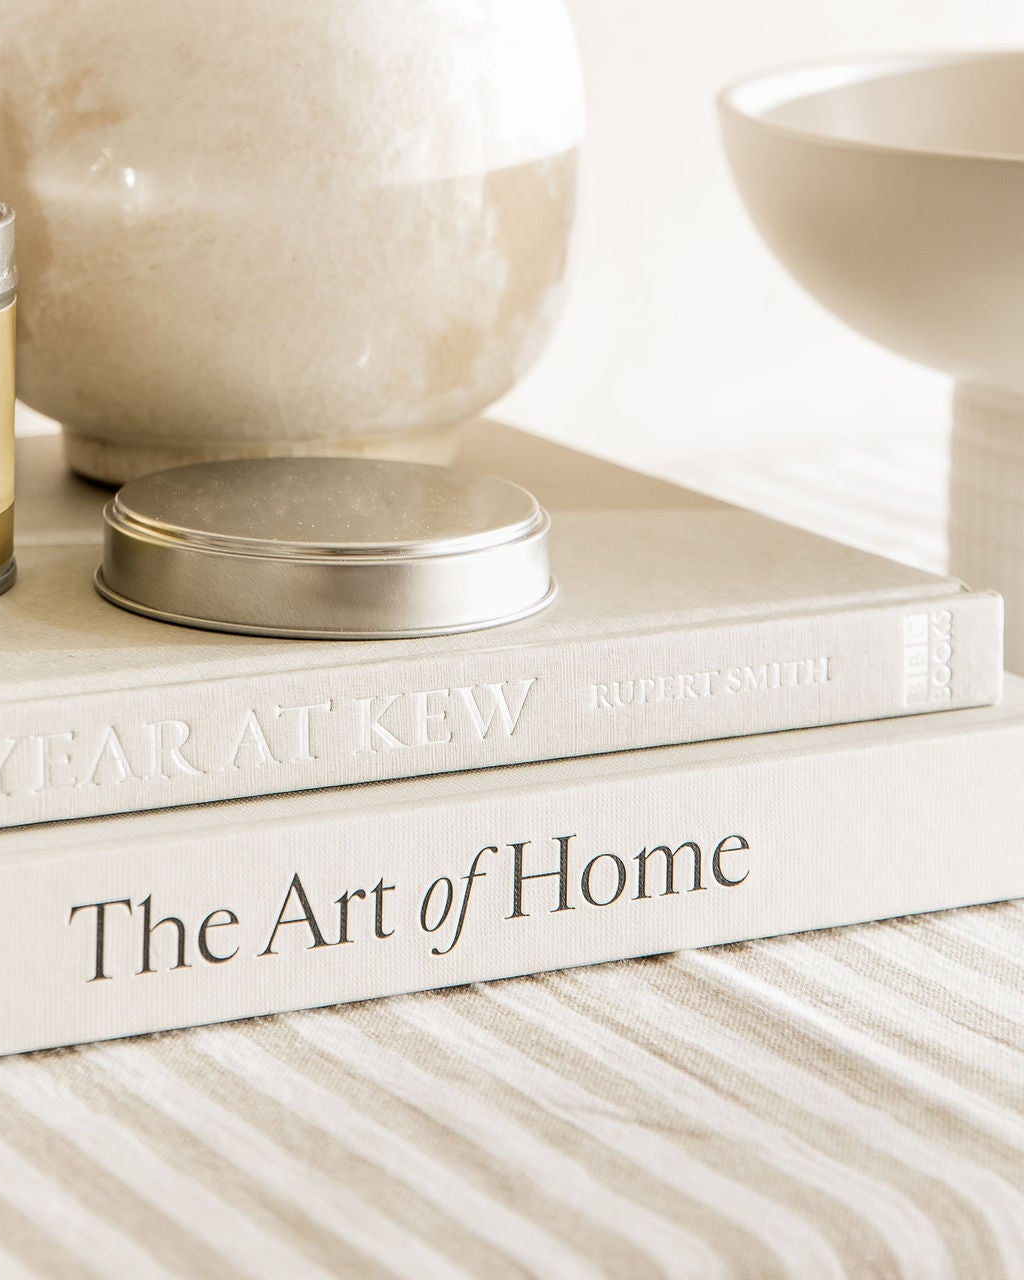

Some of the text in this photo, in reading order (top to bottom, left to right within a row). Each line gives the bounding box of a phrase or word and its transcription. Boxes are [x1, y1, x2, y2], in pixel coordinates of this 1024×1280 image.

[590, 656, 831, 710] RUPERT SMITH
[932, 610, 952, 701] BOOKS
[221, 699, 334, 772] AT
[352, 677, 539, 756] KEW
[70, 832, 751, 983] The Art of Home
